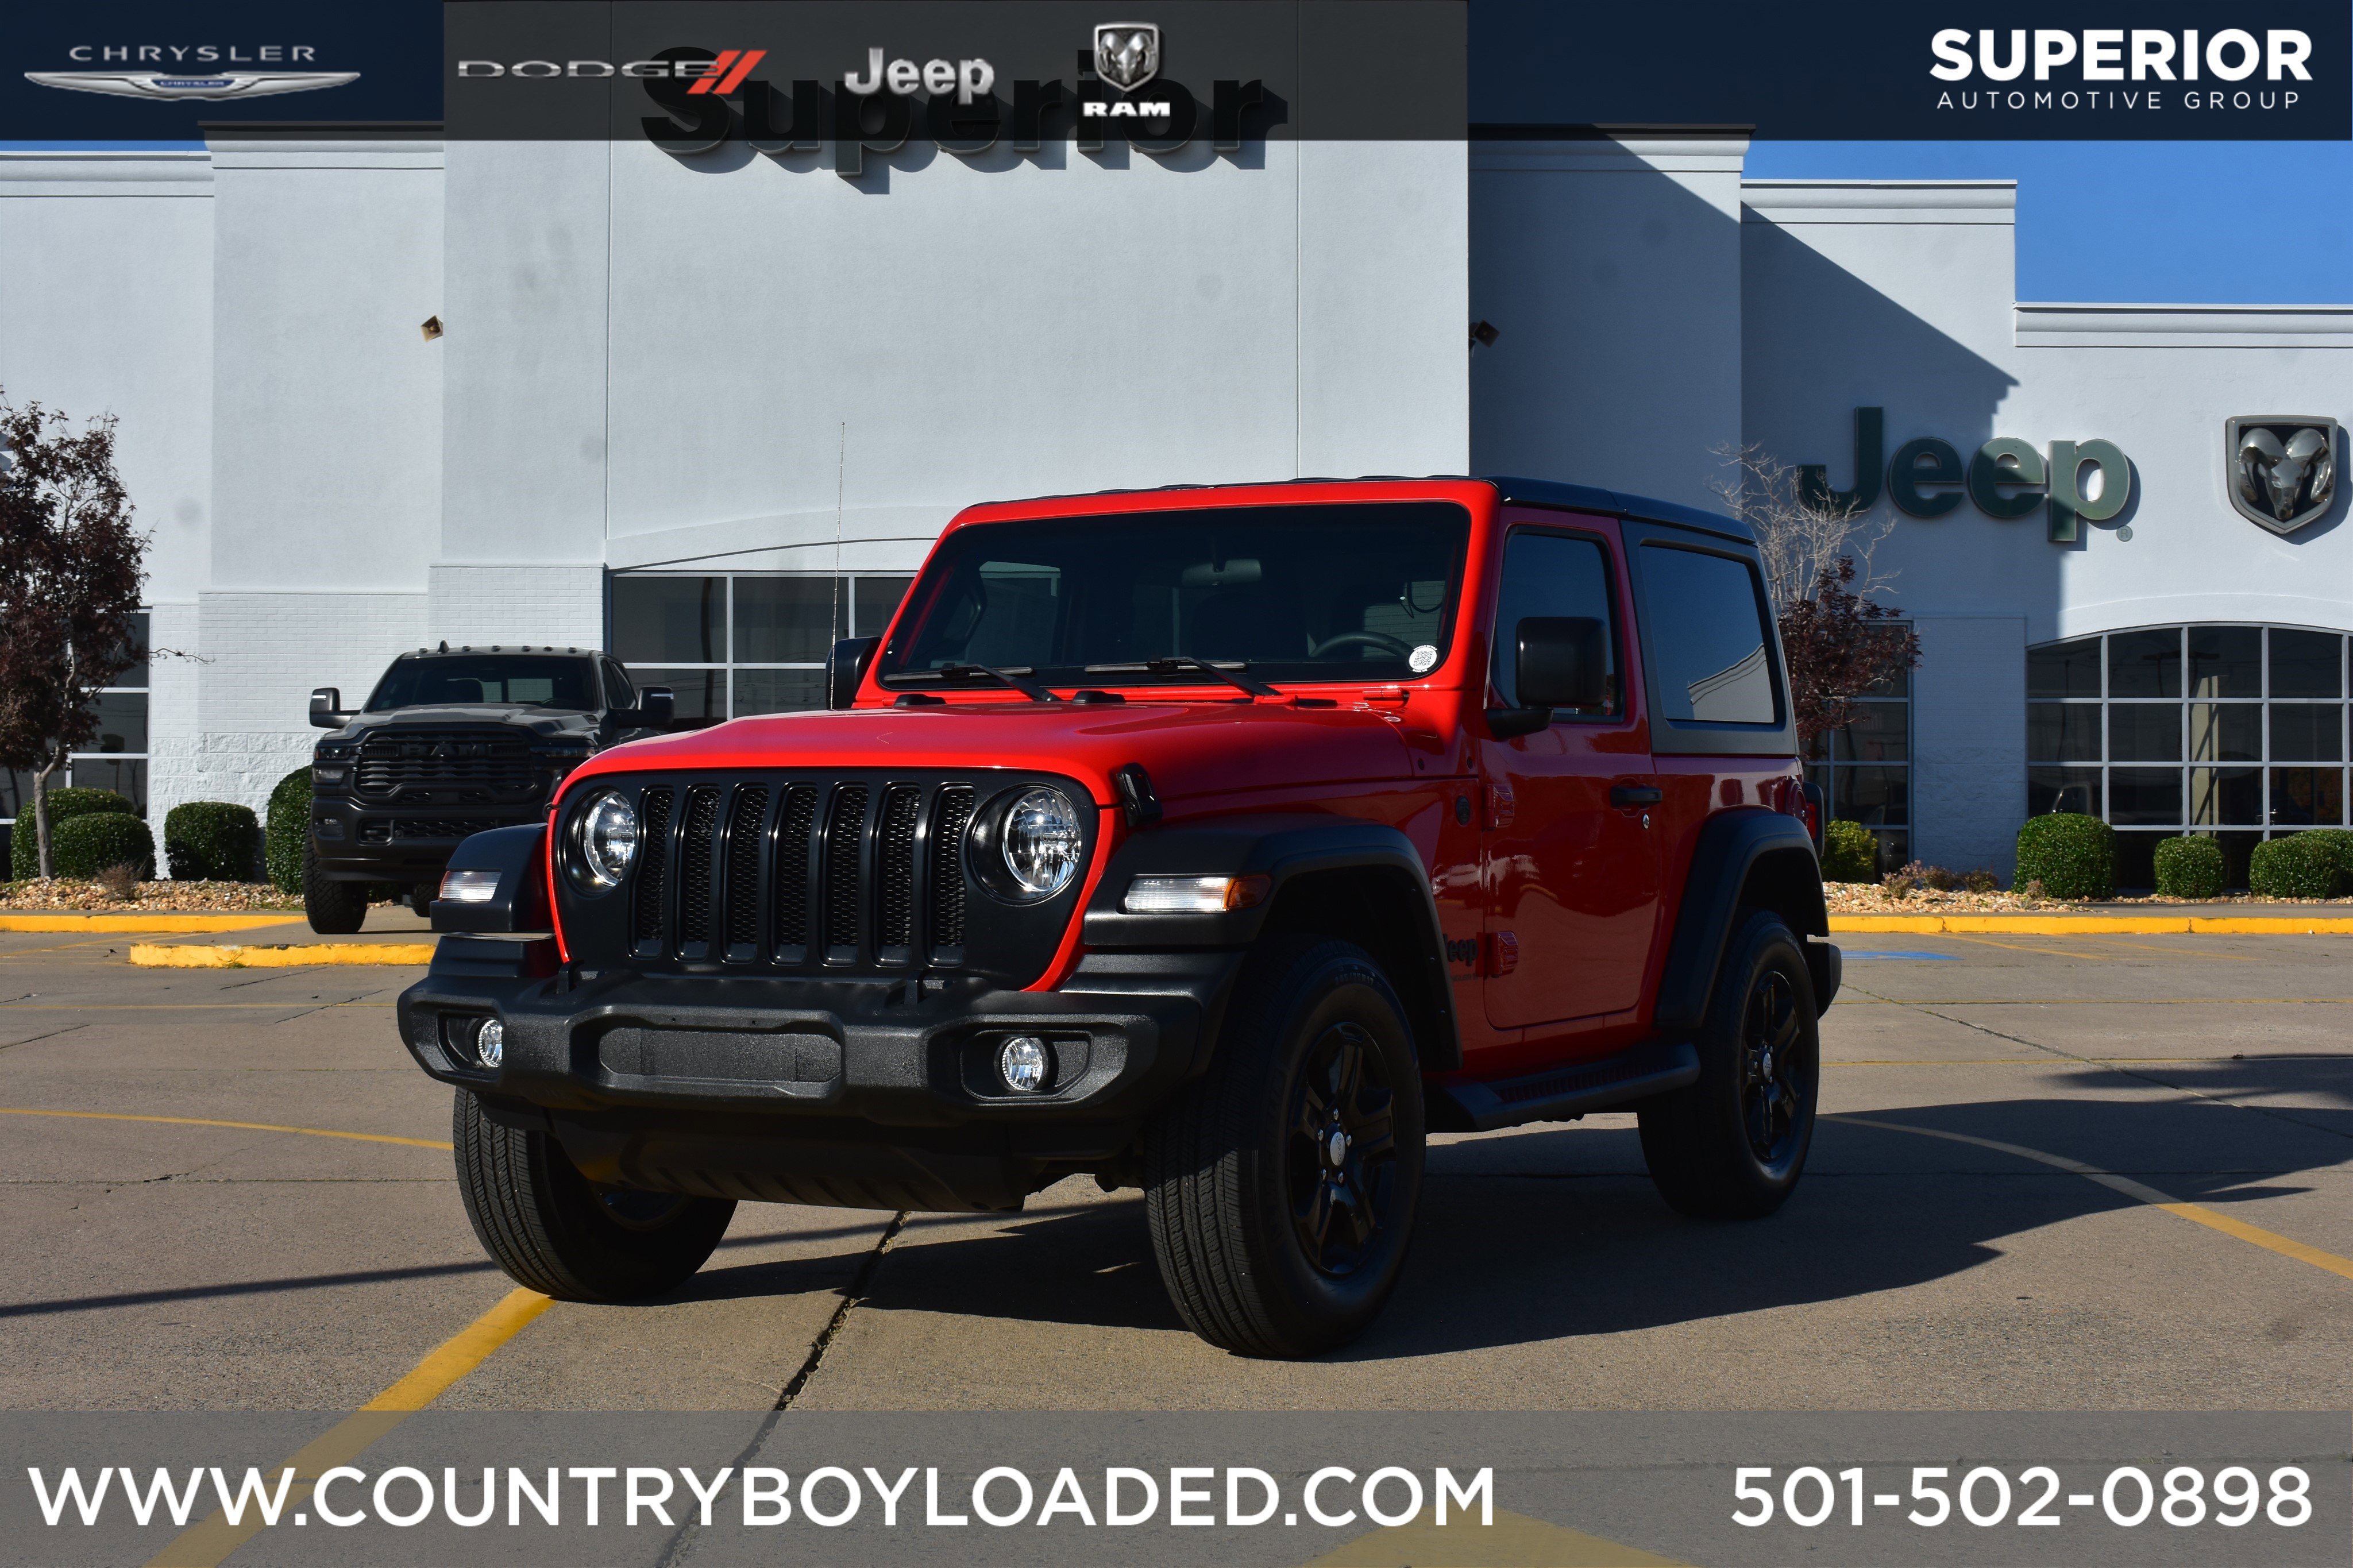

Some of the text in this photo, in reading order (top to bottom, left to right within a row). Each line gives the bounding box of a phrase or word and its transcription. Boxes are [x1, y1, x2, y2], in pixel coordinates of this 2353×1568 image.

[641, 46, 1263, 177] Superior
[1797, 406, 2130, 542] Jeep
[401, 743, 487, 756] RAM
